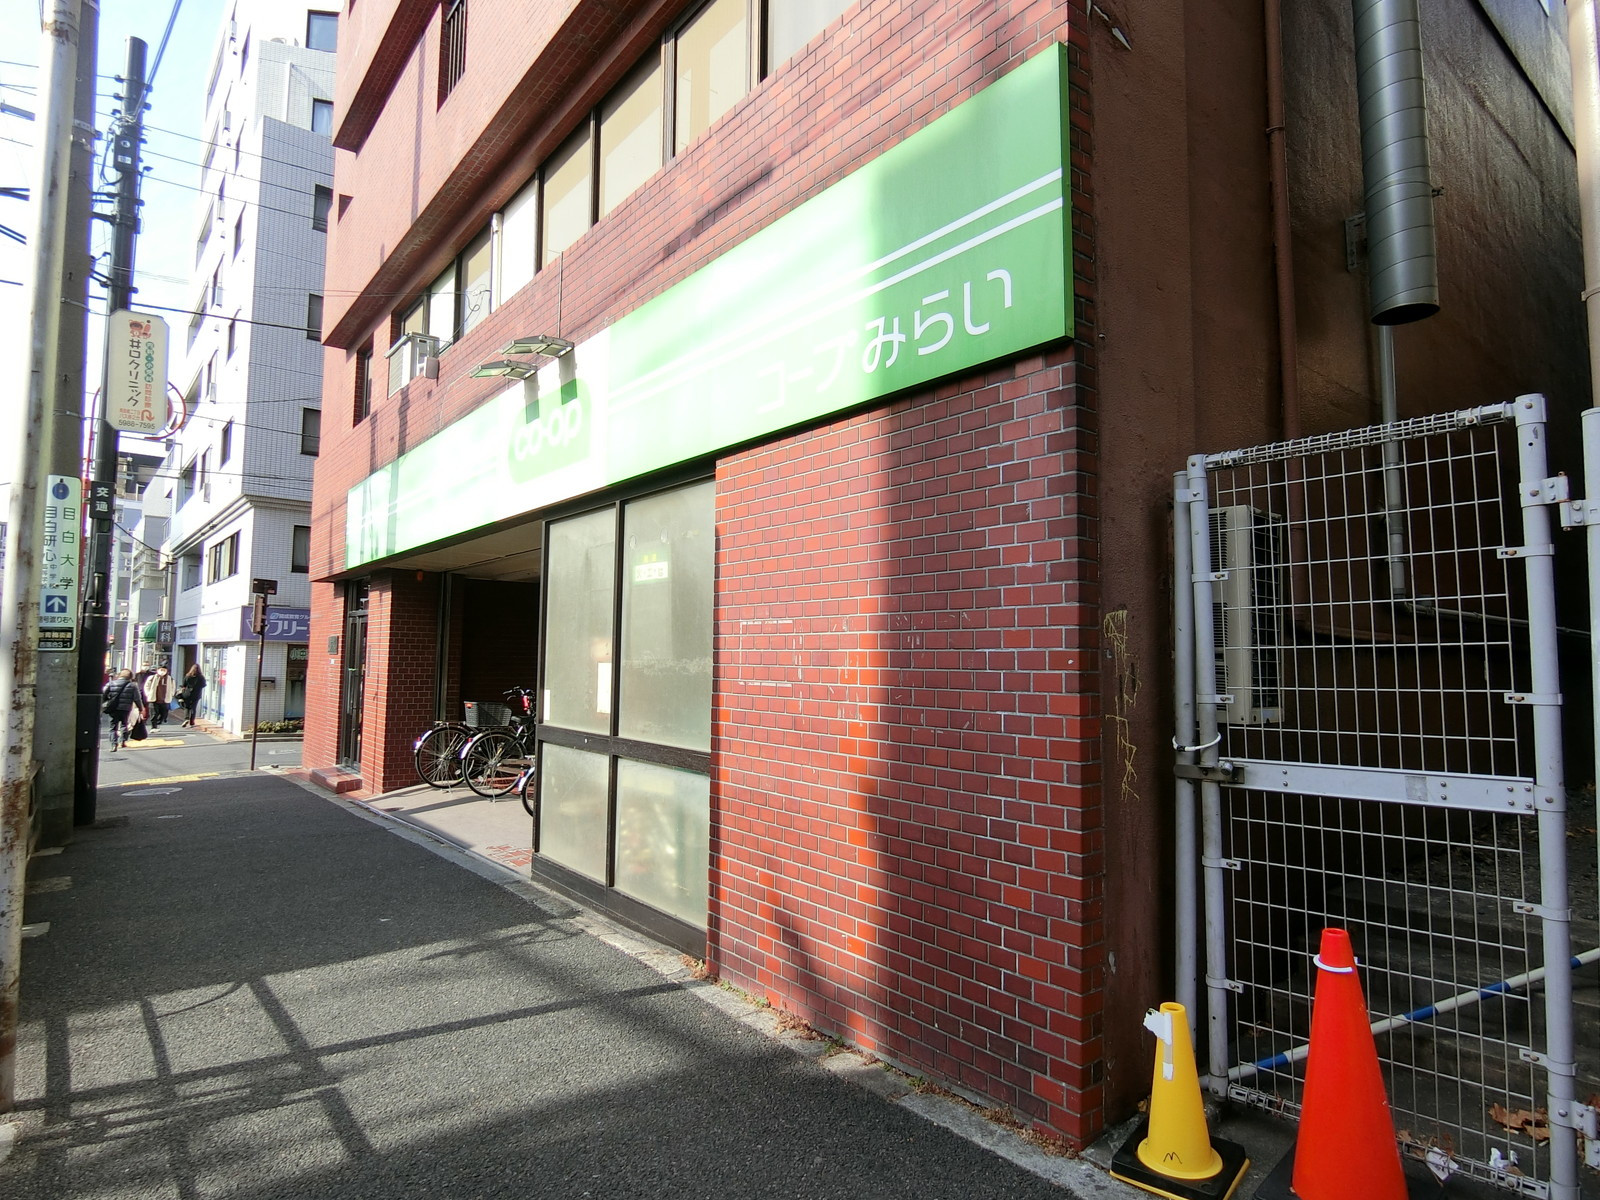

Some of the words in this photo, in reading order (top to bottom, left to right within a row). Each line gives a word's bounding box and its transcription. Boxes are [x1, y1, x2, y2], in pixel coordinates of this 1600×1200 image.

[127, 338, 142, 407] 井口クリニック
[96, 487, 109, 512] 交通
[60, 507, 76, 590] 目白大学
